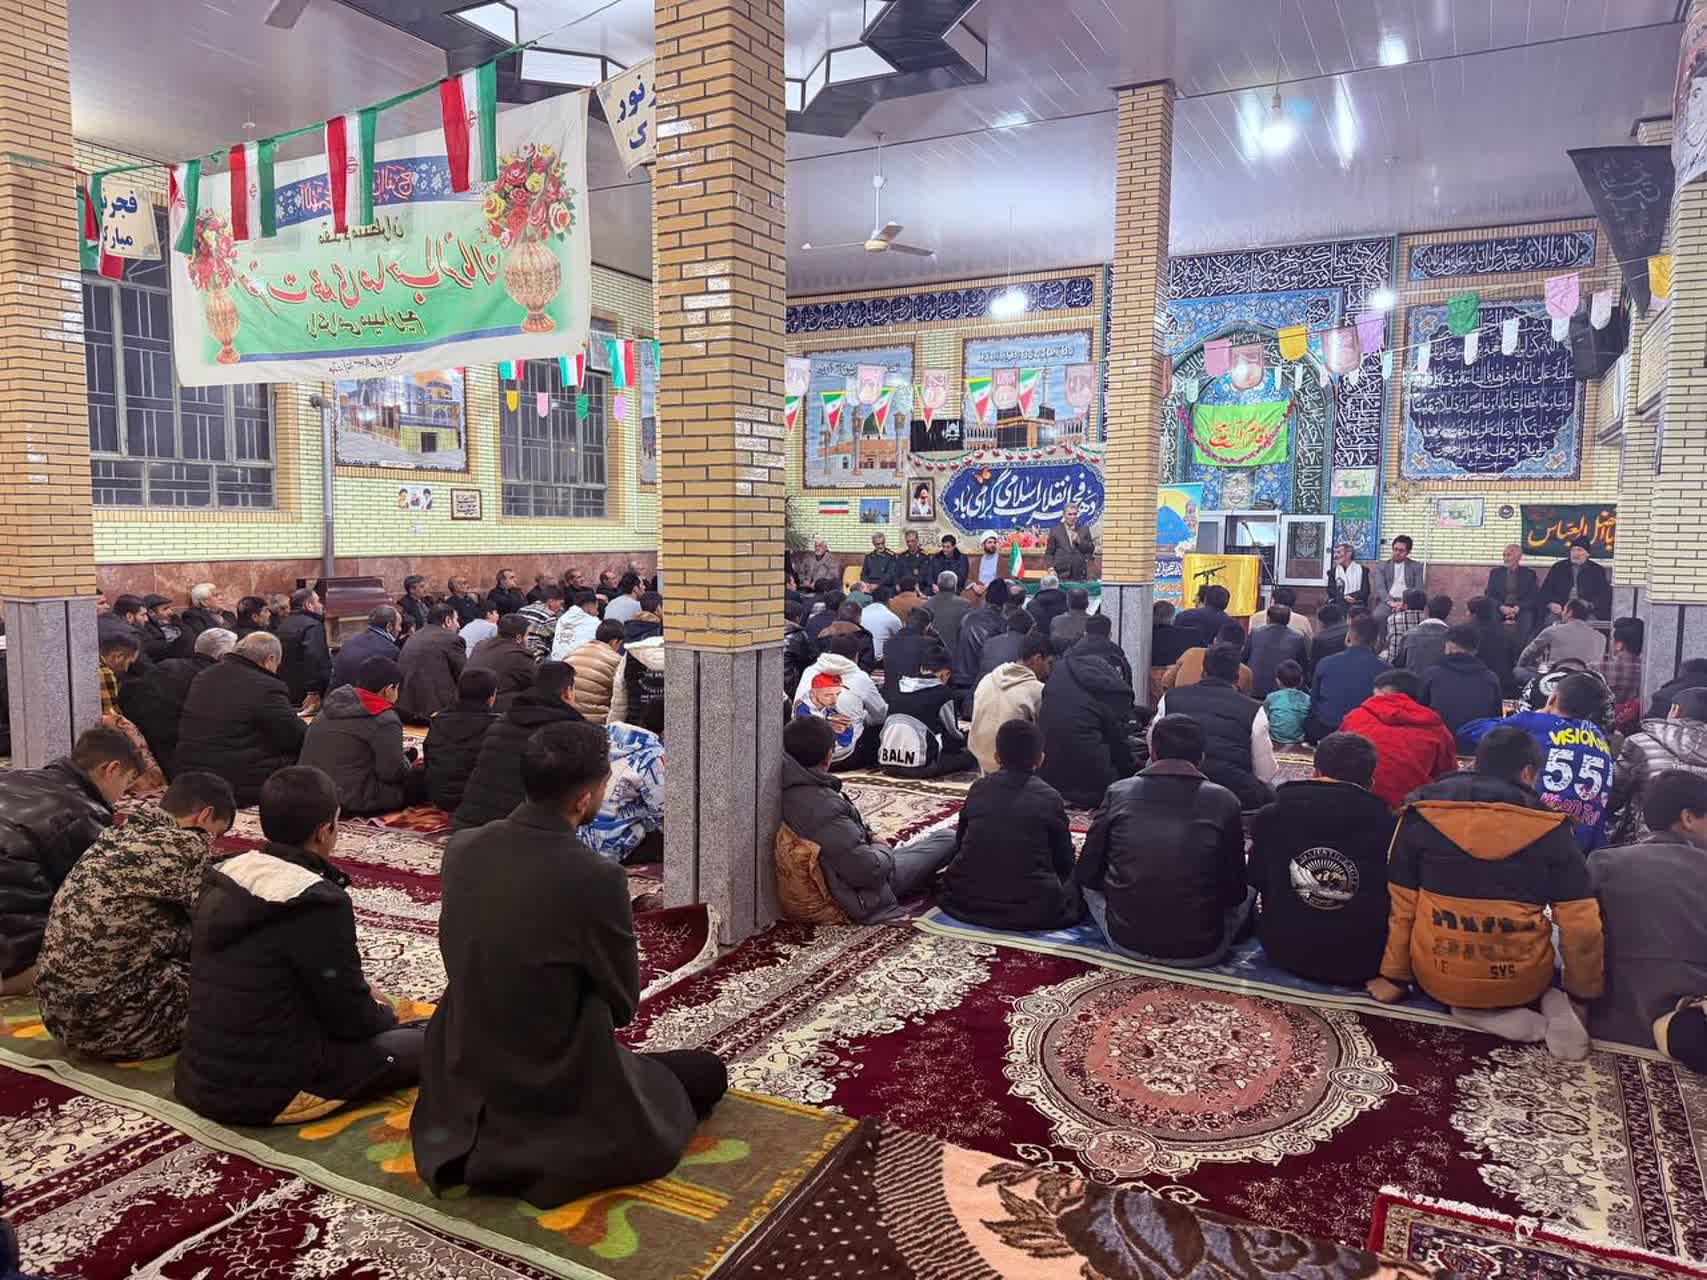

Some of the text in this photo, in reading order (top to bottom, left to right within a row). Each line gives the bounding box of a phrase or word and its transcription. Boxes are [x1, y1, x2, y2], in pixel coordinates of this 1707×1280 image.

[109, 190, 138, 219] فجر
[953, 485, 968, 519] باد
[966, 468, 1013, 519] گرامی
[995, 475, 1042, 508] اسلامی
[882, 748, 915, 765] BALN
